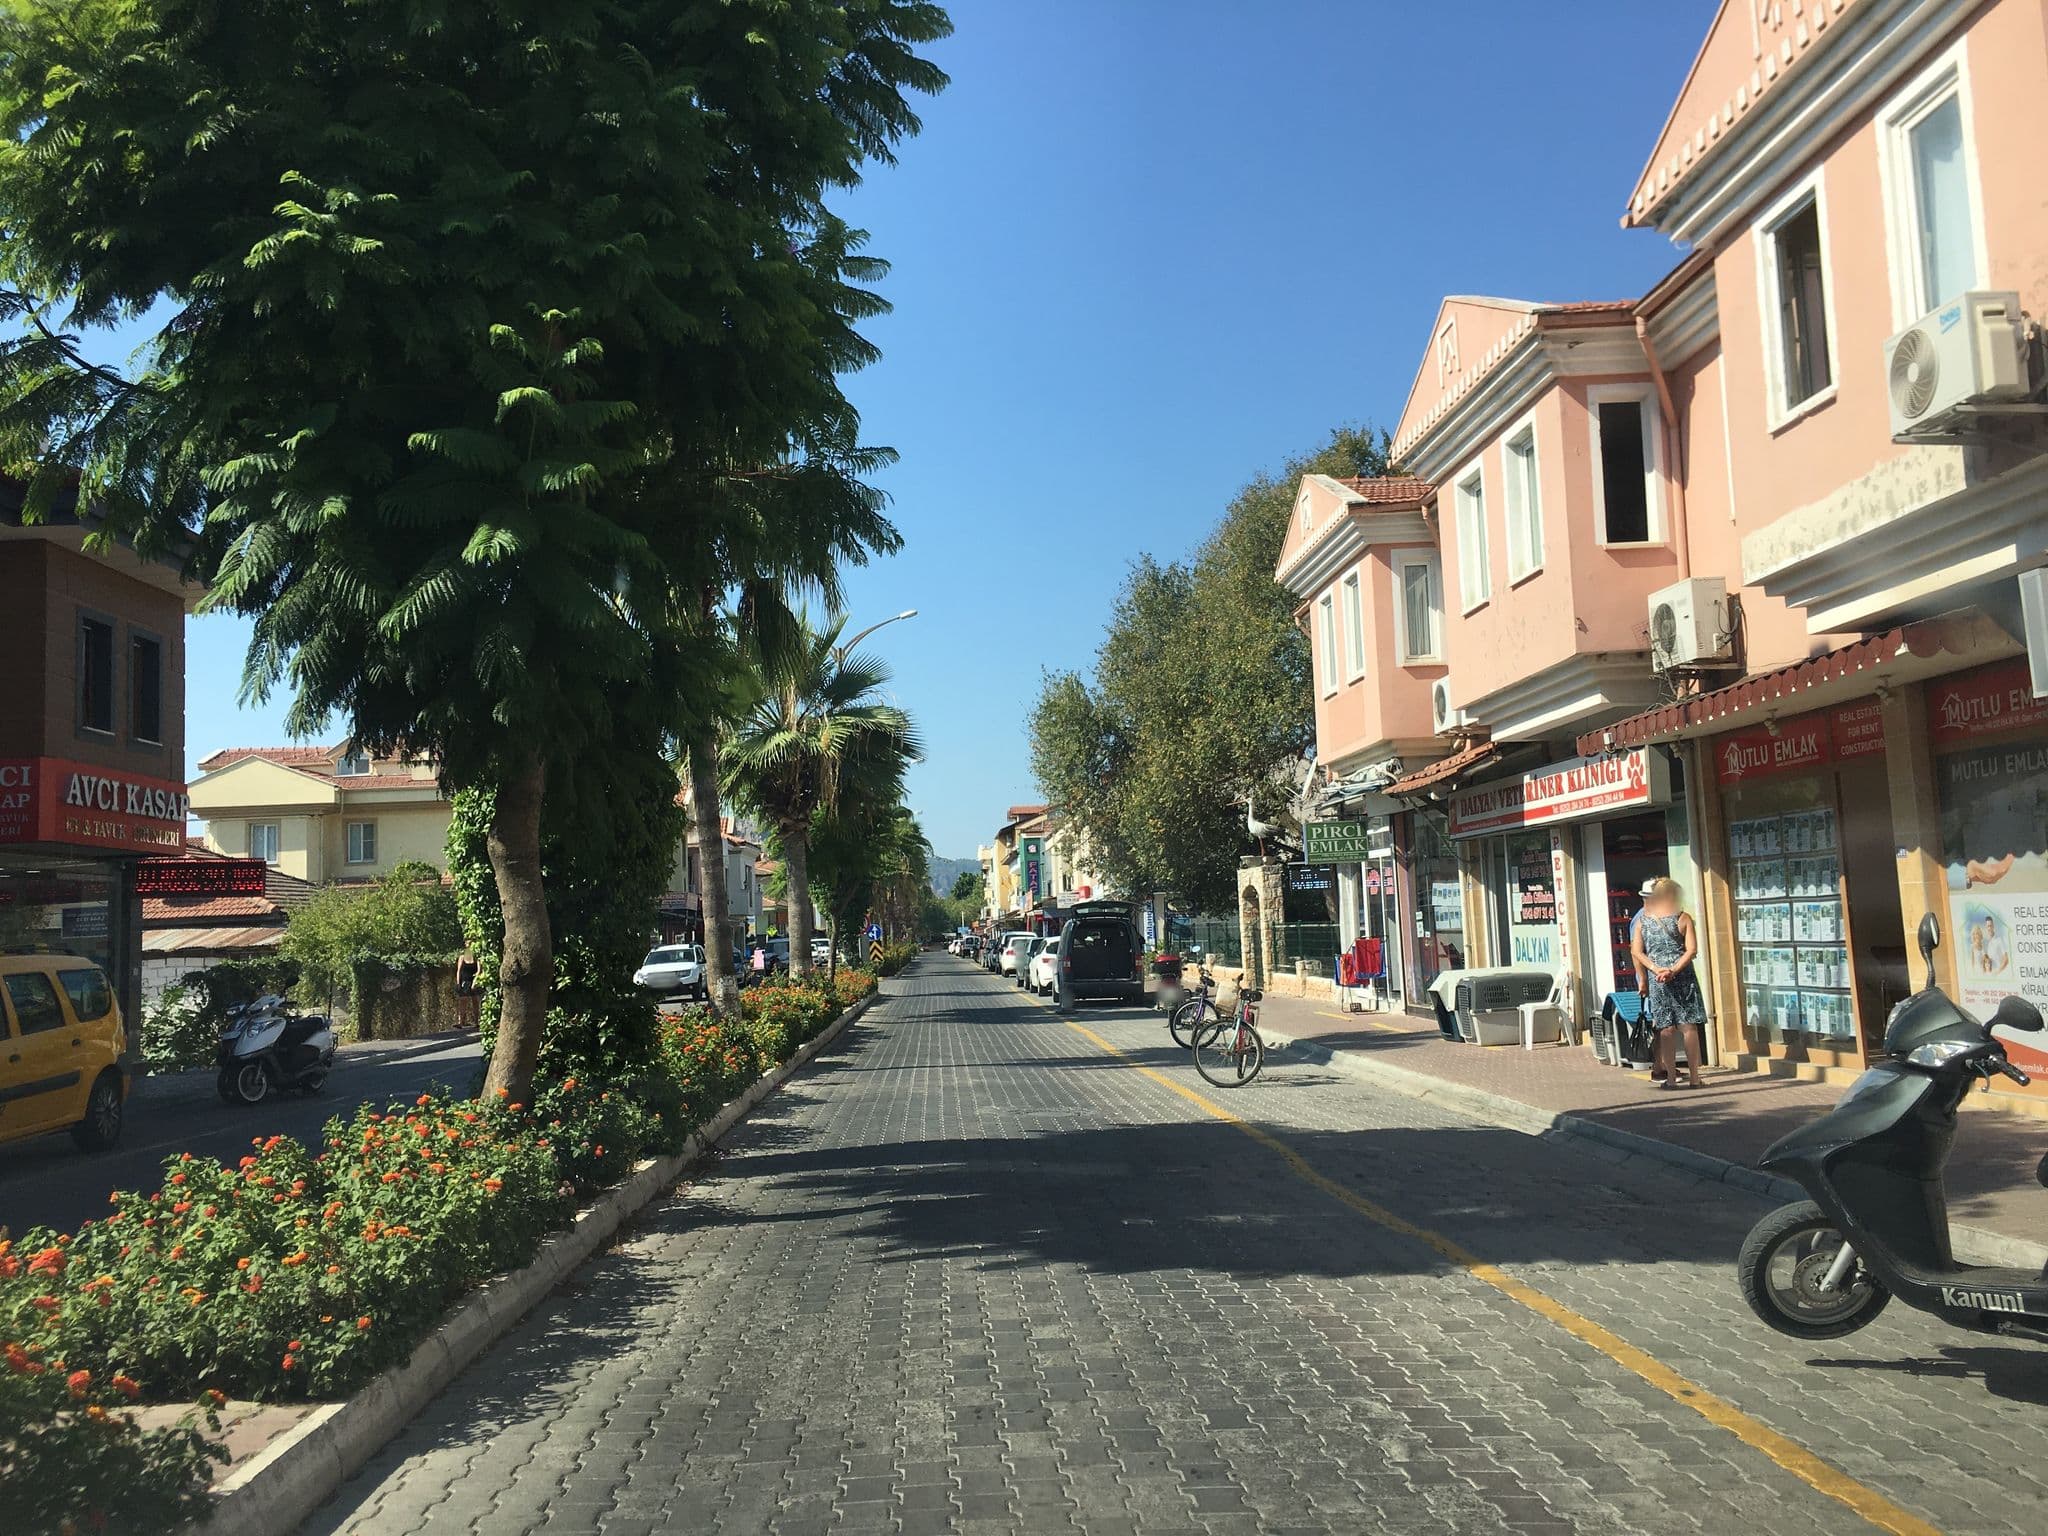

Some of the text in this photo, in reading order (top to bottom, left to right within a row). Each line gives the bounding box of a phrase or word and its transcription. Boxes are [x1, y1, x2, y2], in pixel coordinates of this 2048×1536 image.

[1840, 710, 1856, 723] REAL
[1948, 694, 2001, 723] MUTLU
[1848, 723, 1879, 738] FOR RENT
[1728, 745, 1769, 773] MUTLU
[1774, 733, 1818, 762] EMLAK
[1952, 757, 1998, 782] MUTLU
[66, 772, 191, 822] AVCI KASAP
[1461, 754, 1623, 818] DALYAN VETERİNER KLİNİĞİ
[83, 818, 91, 835] &
[94, 820, 126, 840] TAVUK
[1311, 822, 1362, 839] PİRCİ
[1309, 840, 1366, 853] EMLAK
[2013, 906, 2038, 919] REAL
[2016, 924, 2035, 936] FOR
[1515, 936, 1549, 963] DALYAN
[1942, 1287, 2025, 1313] Kanuni
